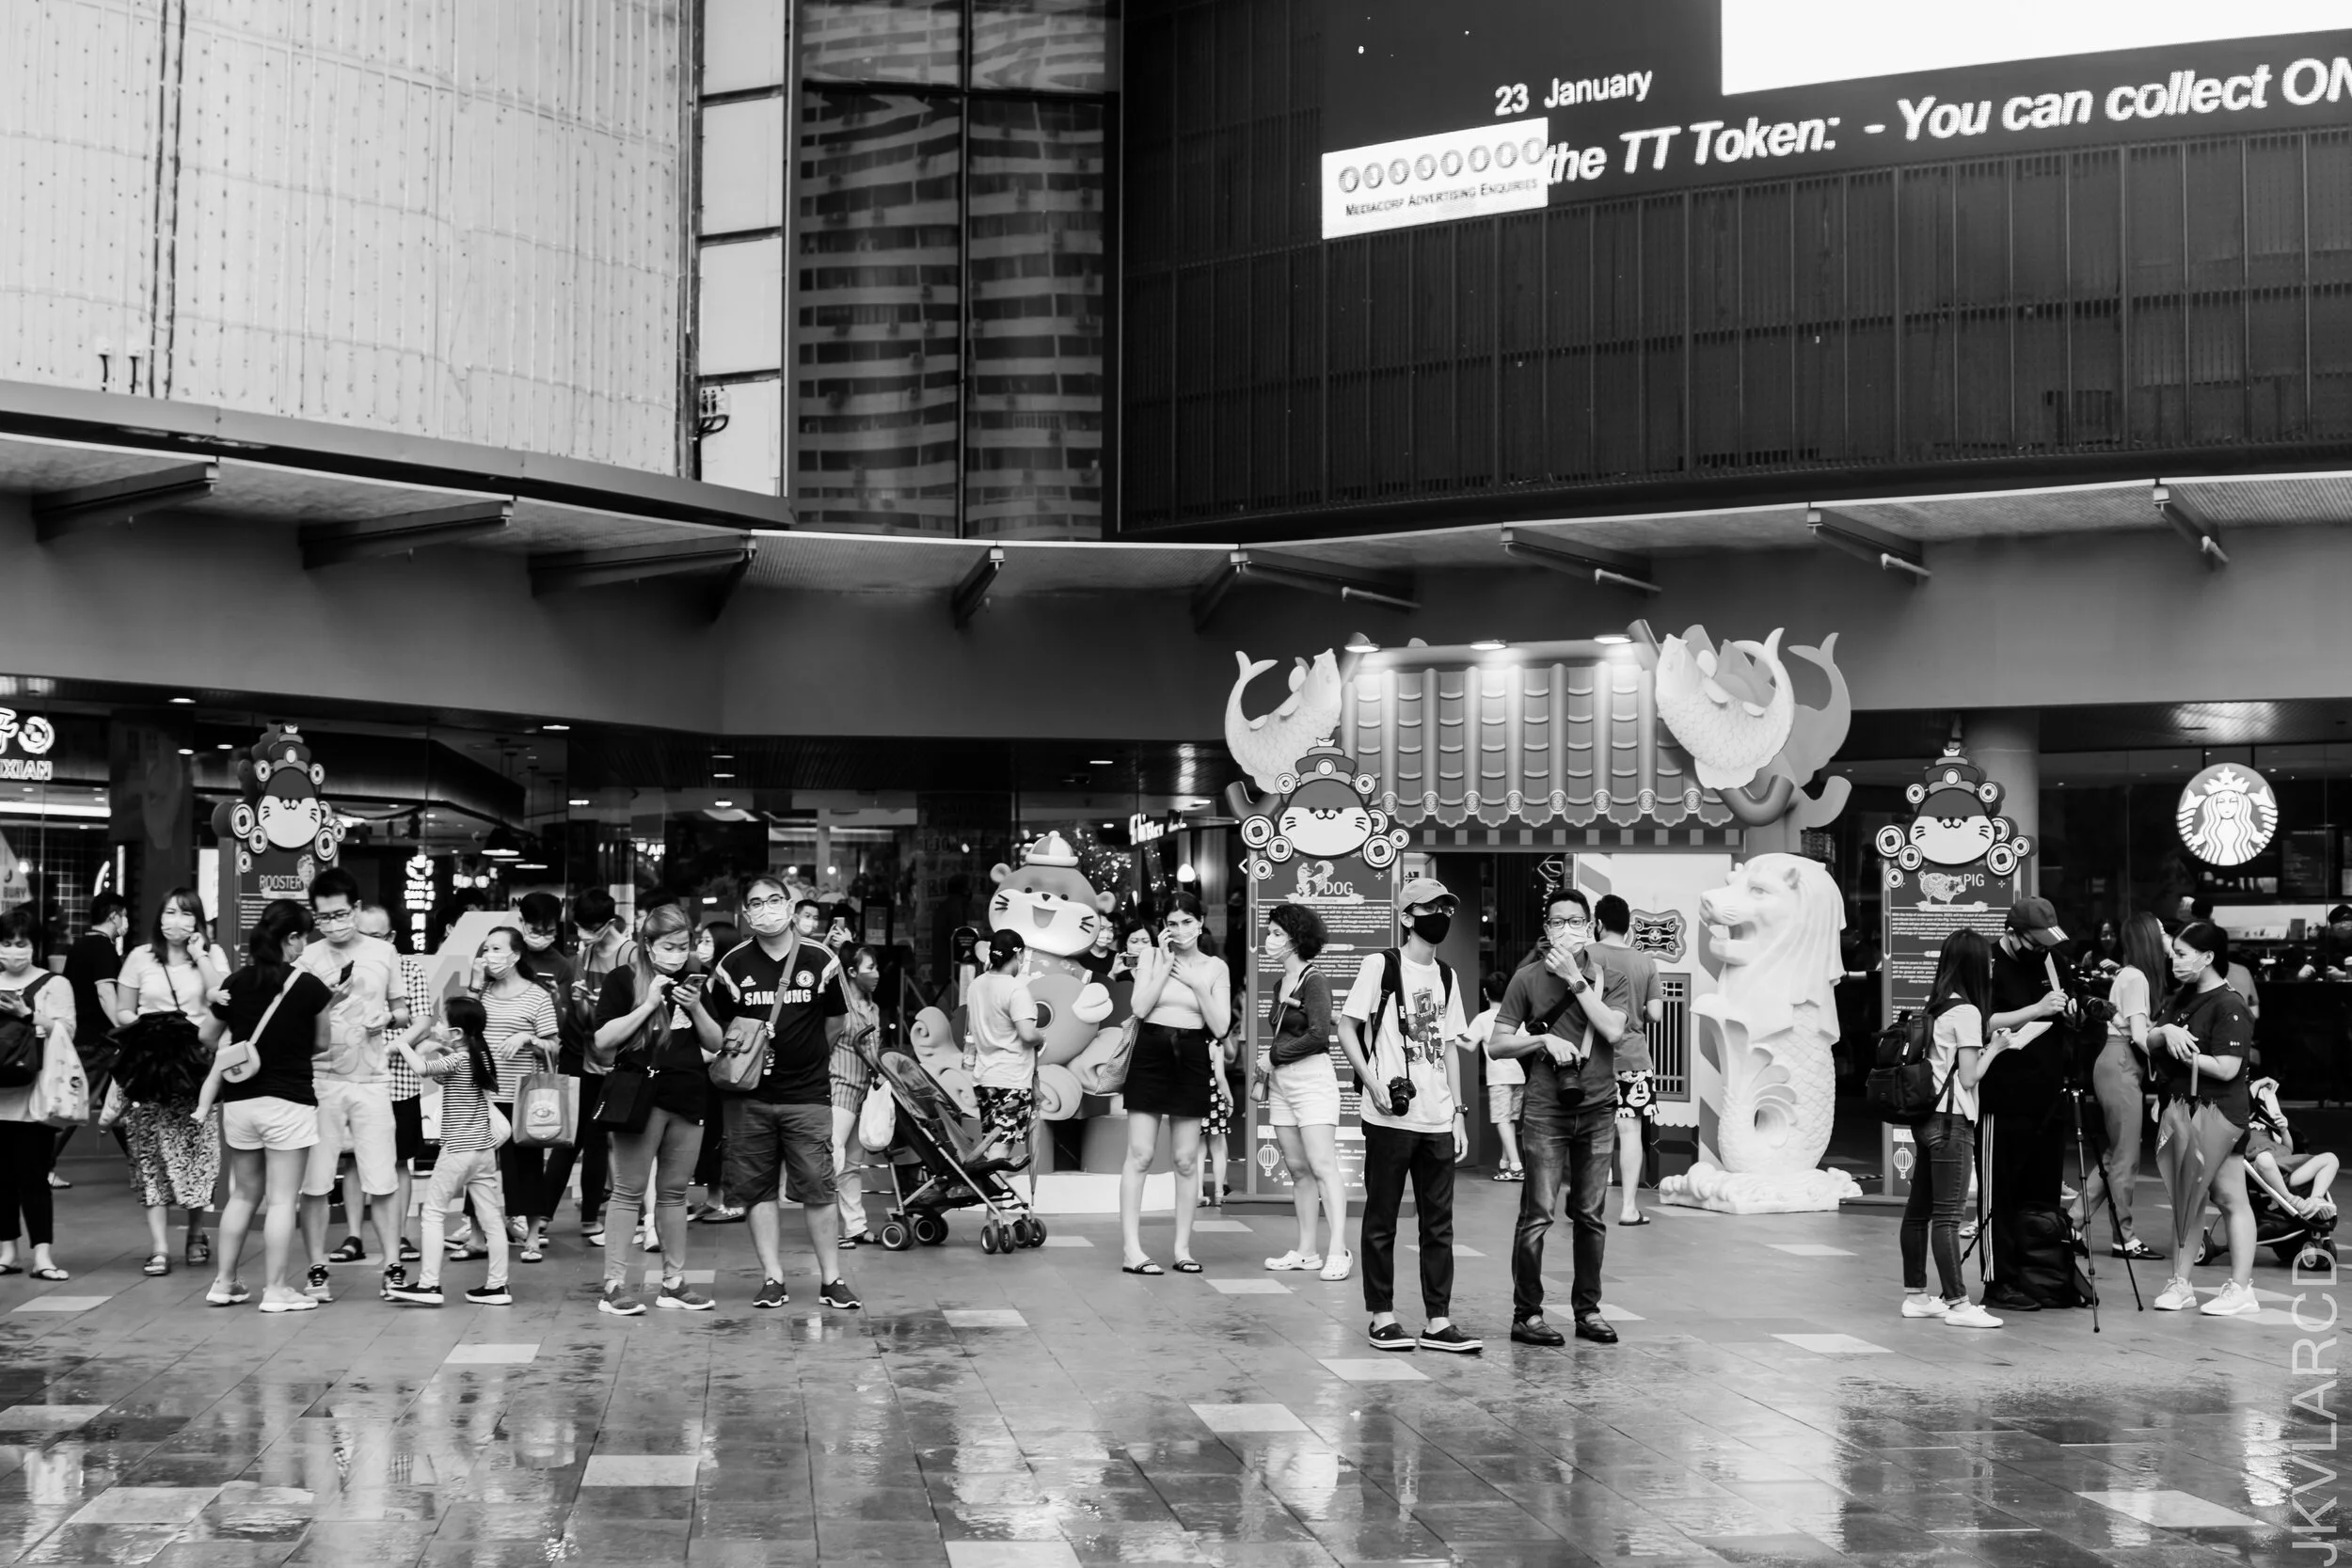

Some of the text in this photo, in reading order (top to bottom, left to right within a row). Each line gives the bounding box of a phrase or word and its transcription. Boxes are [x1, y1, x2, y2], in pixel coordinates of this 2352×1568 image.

[1495, 71, 1653, 116] 23 January
[1548, 140, 1608, 186] the
[1619, 125, 1681, 174] TT
[1689, 116, 1841, 166] Token:
[1897, 95, 1992, 142] You
[2001, 88, 2094, 132] can
[2104, 64, 2274, 122] collect
[259, 875, 302, 890] ROOSTER
[1324, 880, 1354, 895] DOG
[1963, 873, 1986, 887] PIG
[744, 989, 812, 1006] SAMUNG
